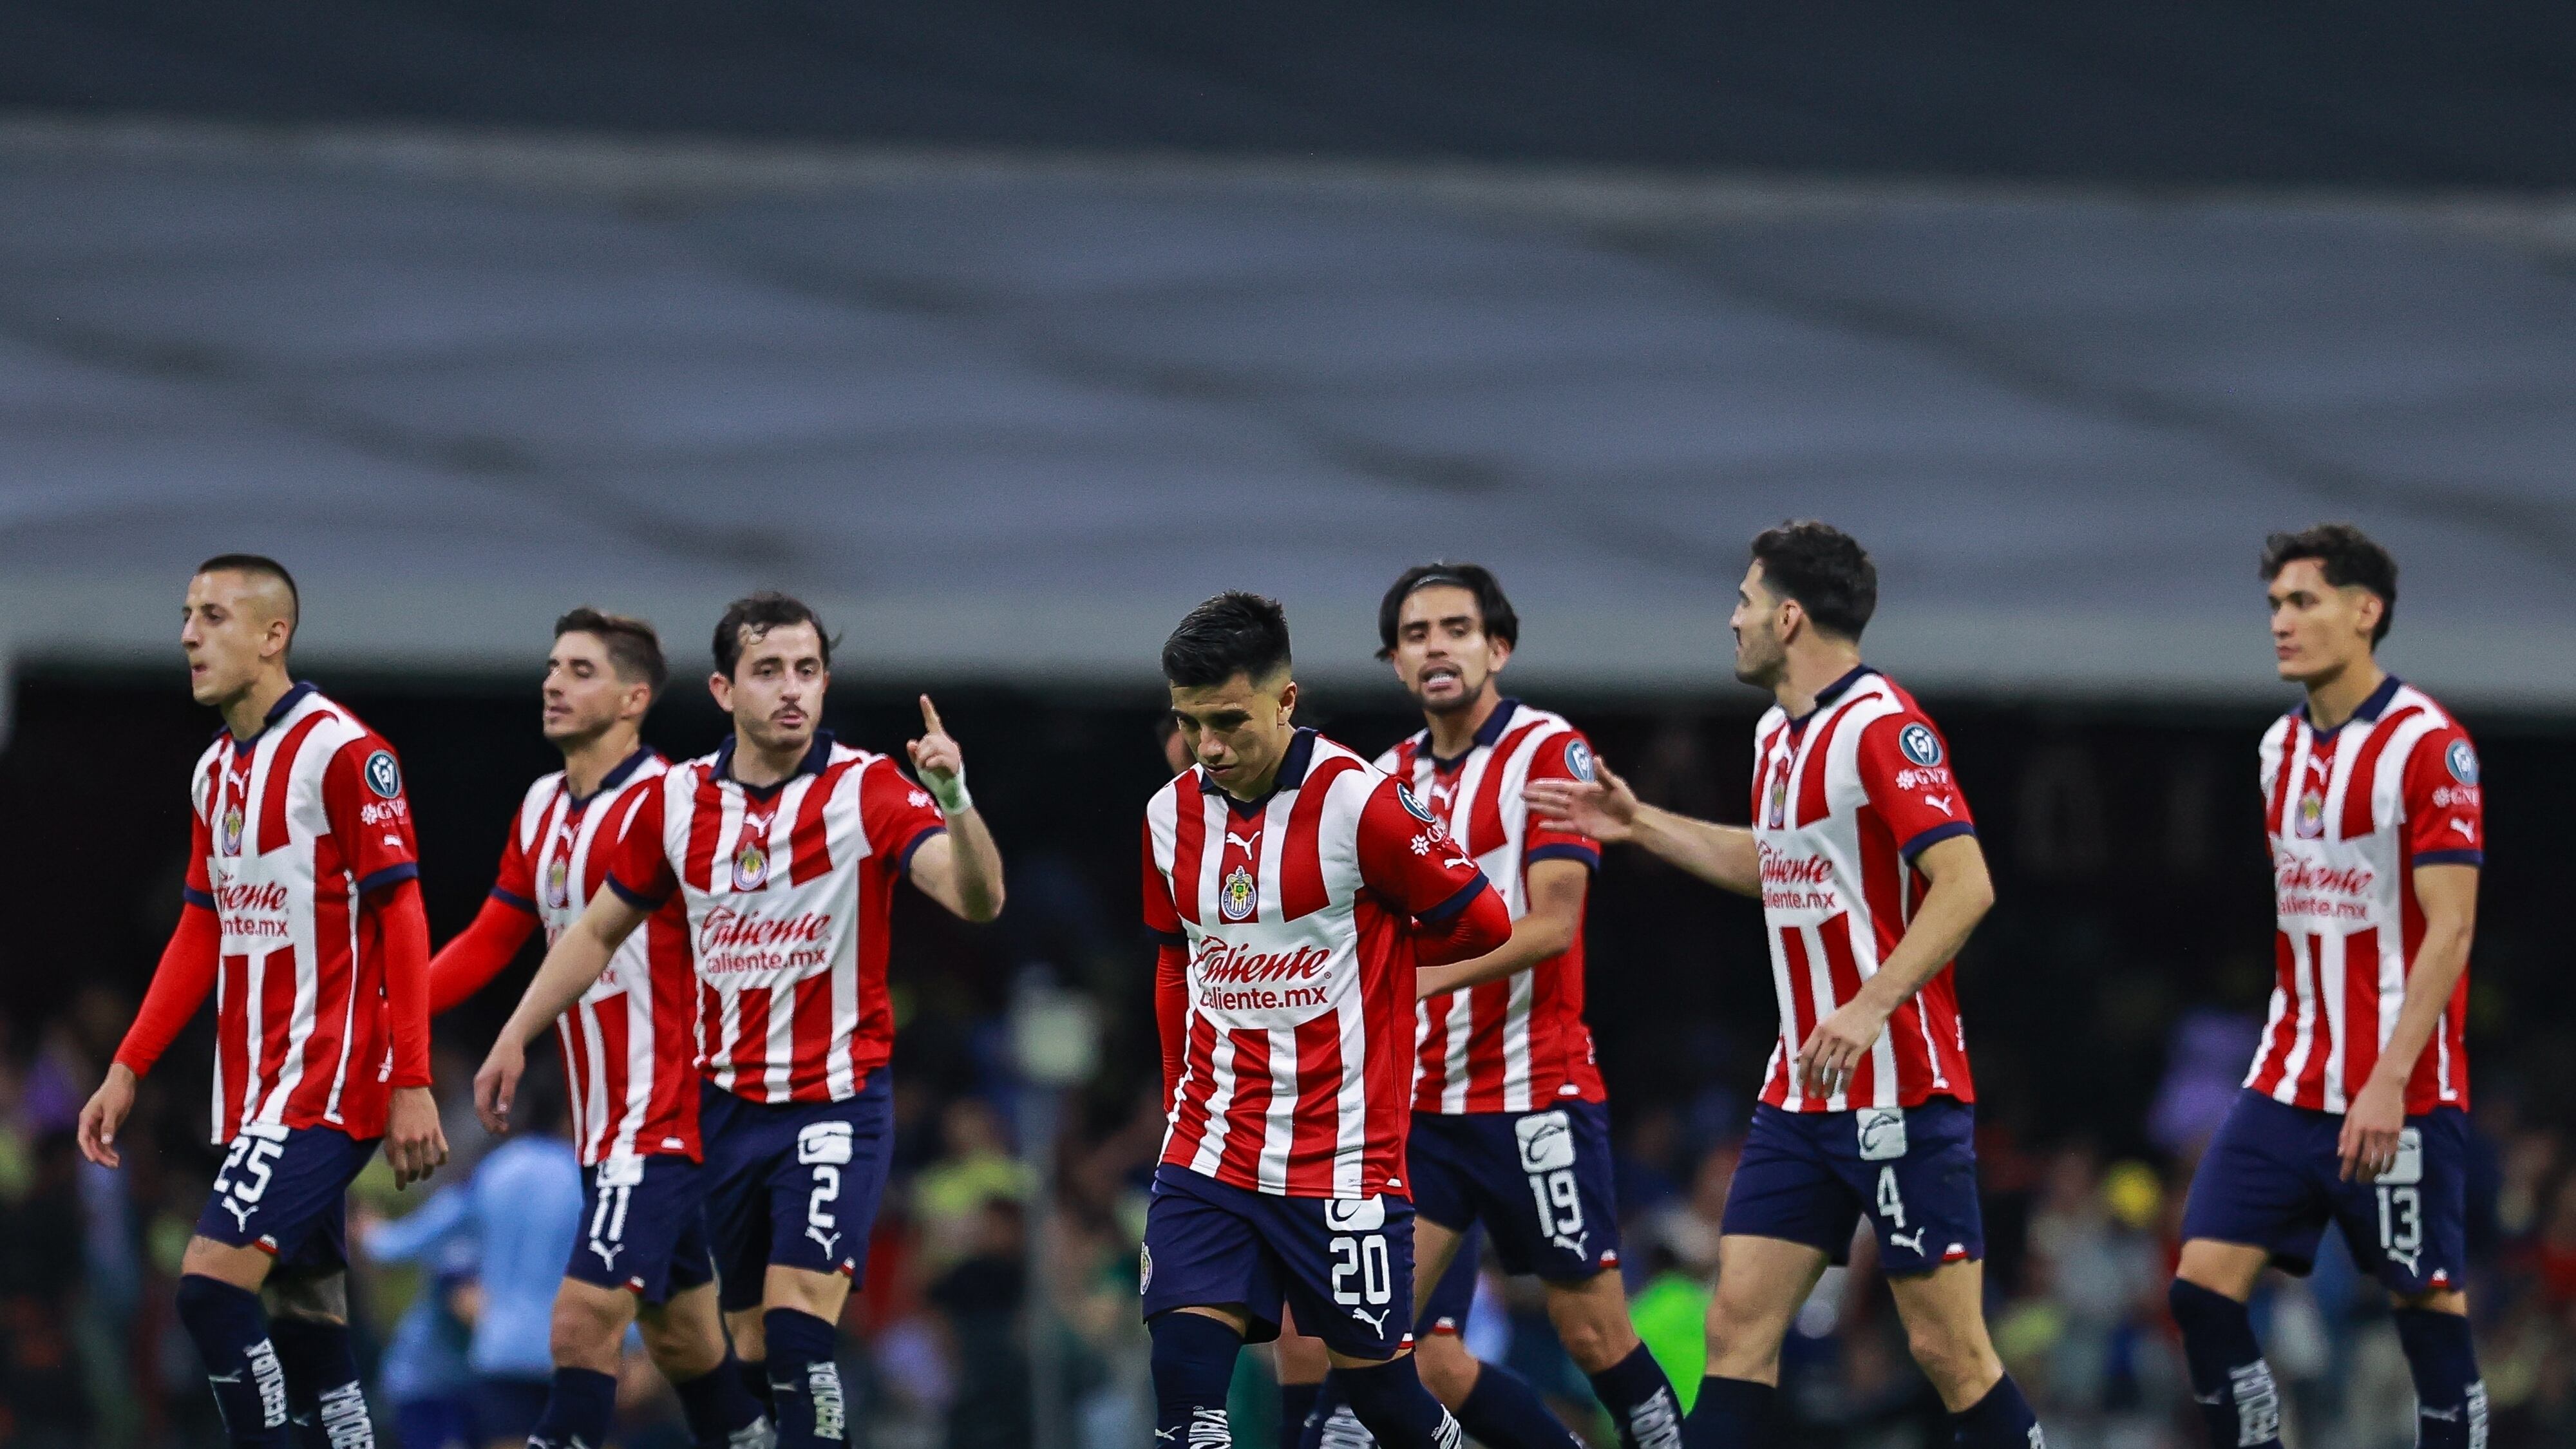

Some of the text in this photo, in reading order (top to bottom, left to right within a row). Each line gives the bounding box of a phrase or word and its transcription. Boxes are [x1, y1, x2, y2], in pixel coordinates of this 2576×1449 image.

[699, 904, 832, 958] Caliente
[1192, 934, 1331, 984] Caliente
[213, 1135, 284, 1204] 25
[808, 1164, 840, 1229] 2
[1877, 1165, 1908, 1229] 4
[589, 1185, 632, 1242] 11
[1528, 1171, 1585, 1238] 19
[2375, 1186, 2423, 1251] 13
[1329, 1234, 1392, 1305] 20
